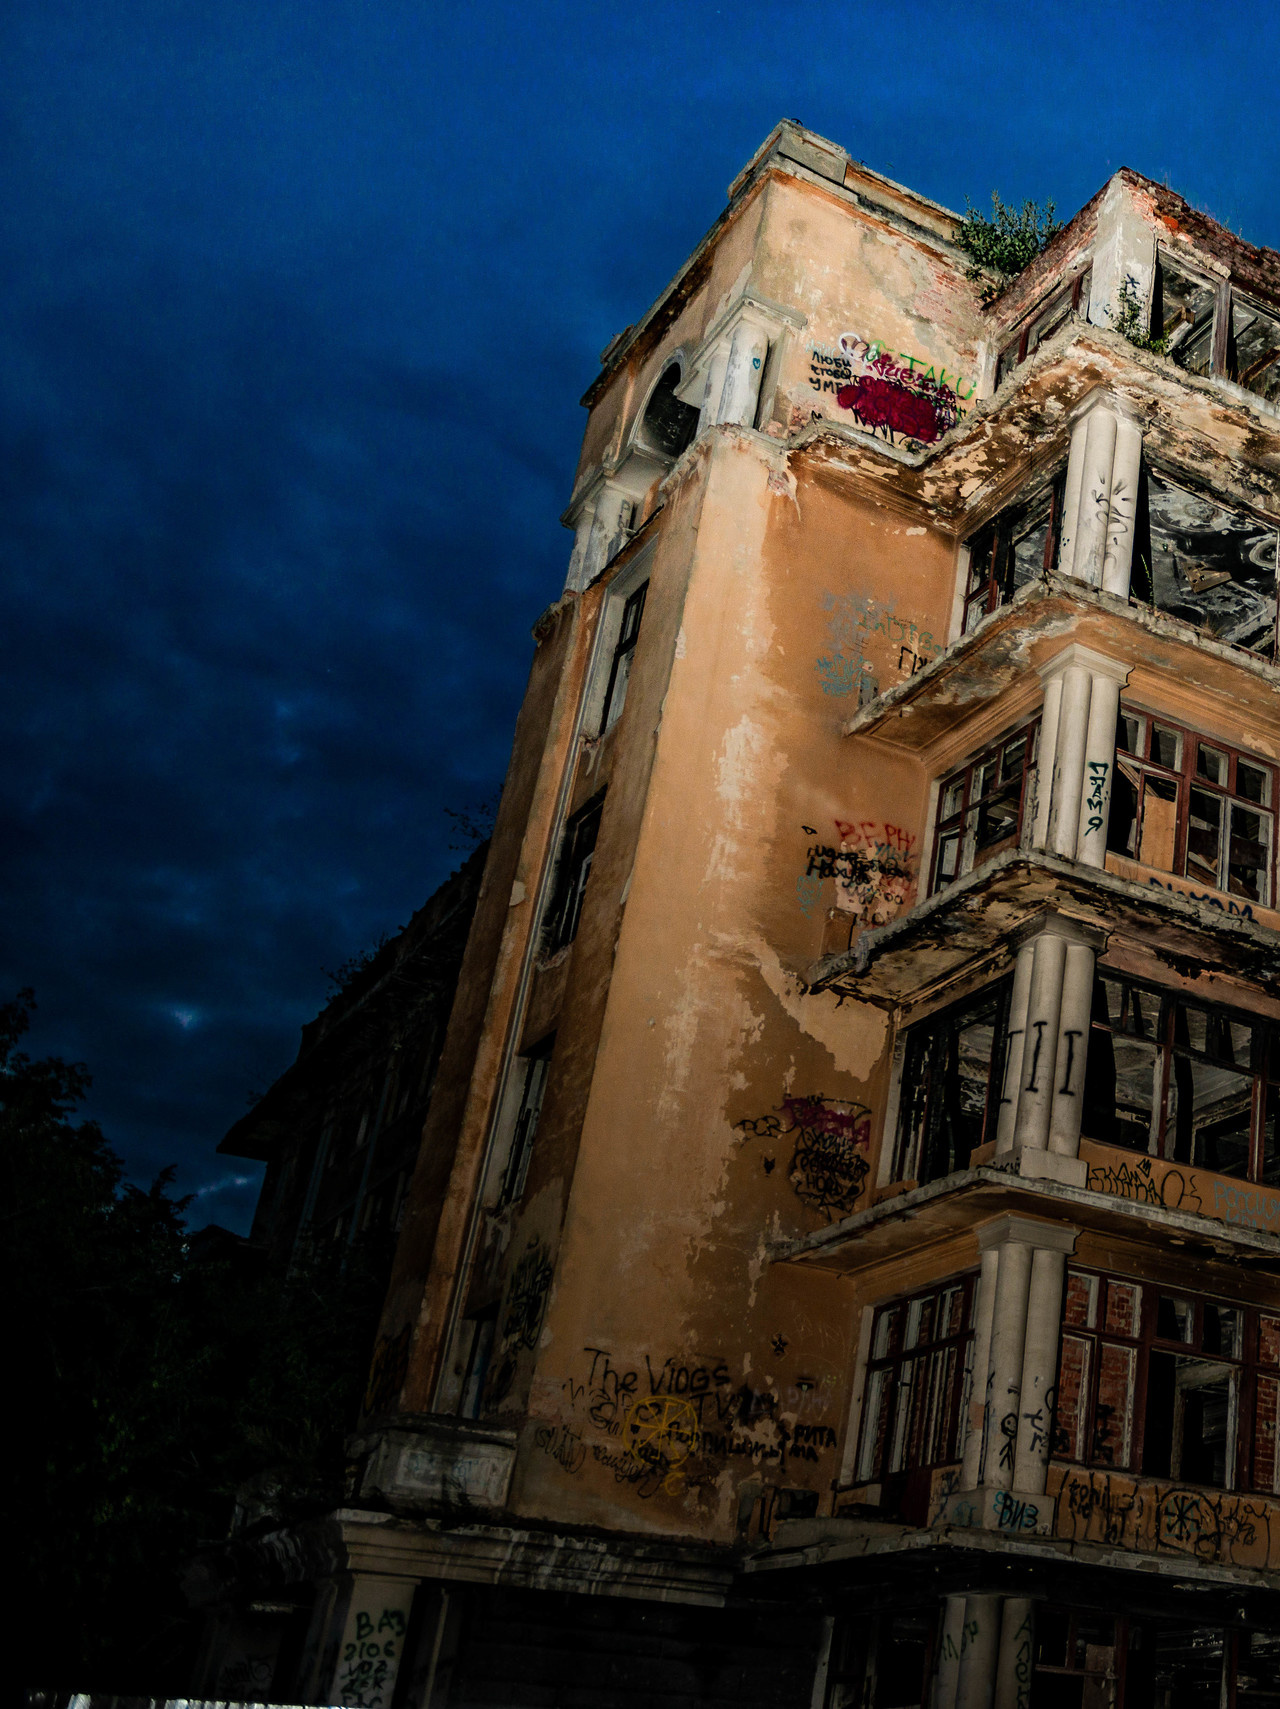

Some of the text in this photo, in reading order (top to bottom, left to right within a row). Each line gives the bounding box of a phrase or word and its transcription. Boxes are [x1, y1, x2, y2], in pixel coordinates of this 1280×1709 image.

[584, 1347, 639, 1394] The
[356, 1609, 406, 1640] ВАЗ
[344, 1641, 394, 1661] 2106
